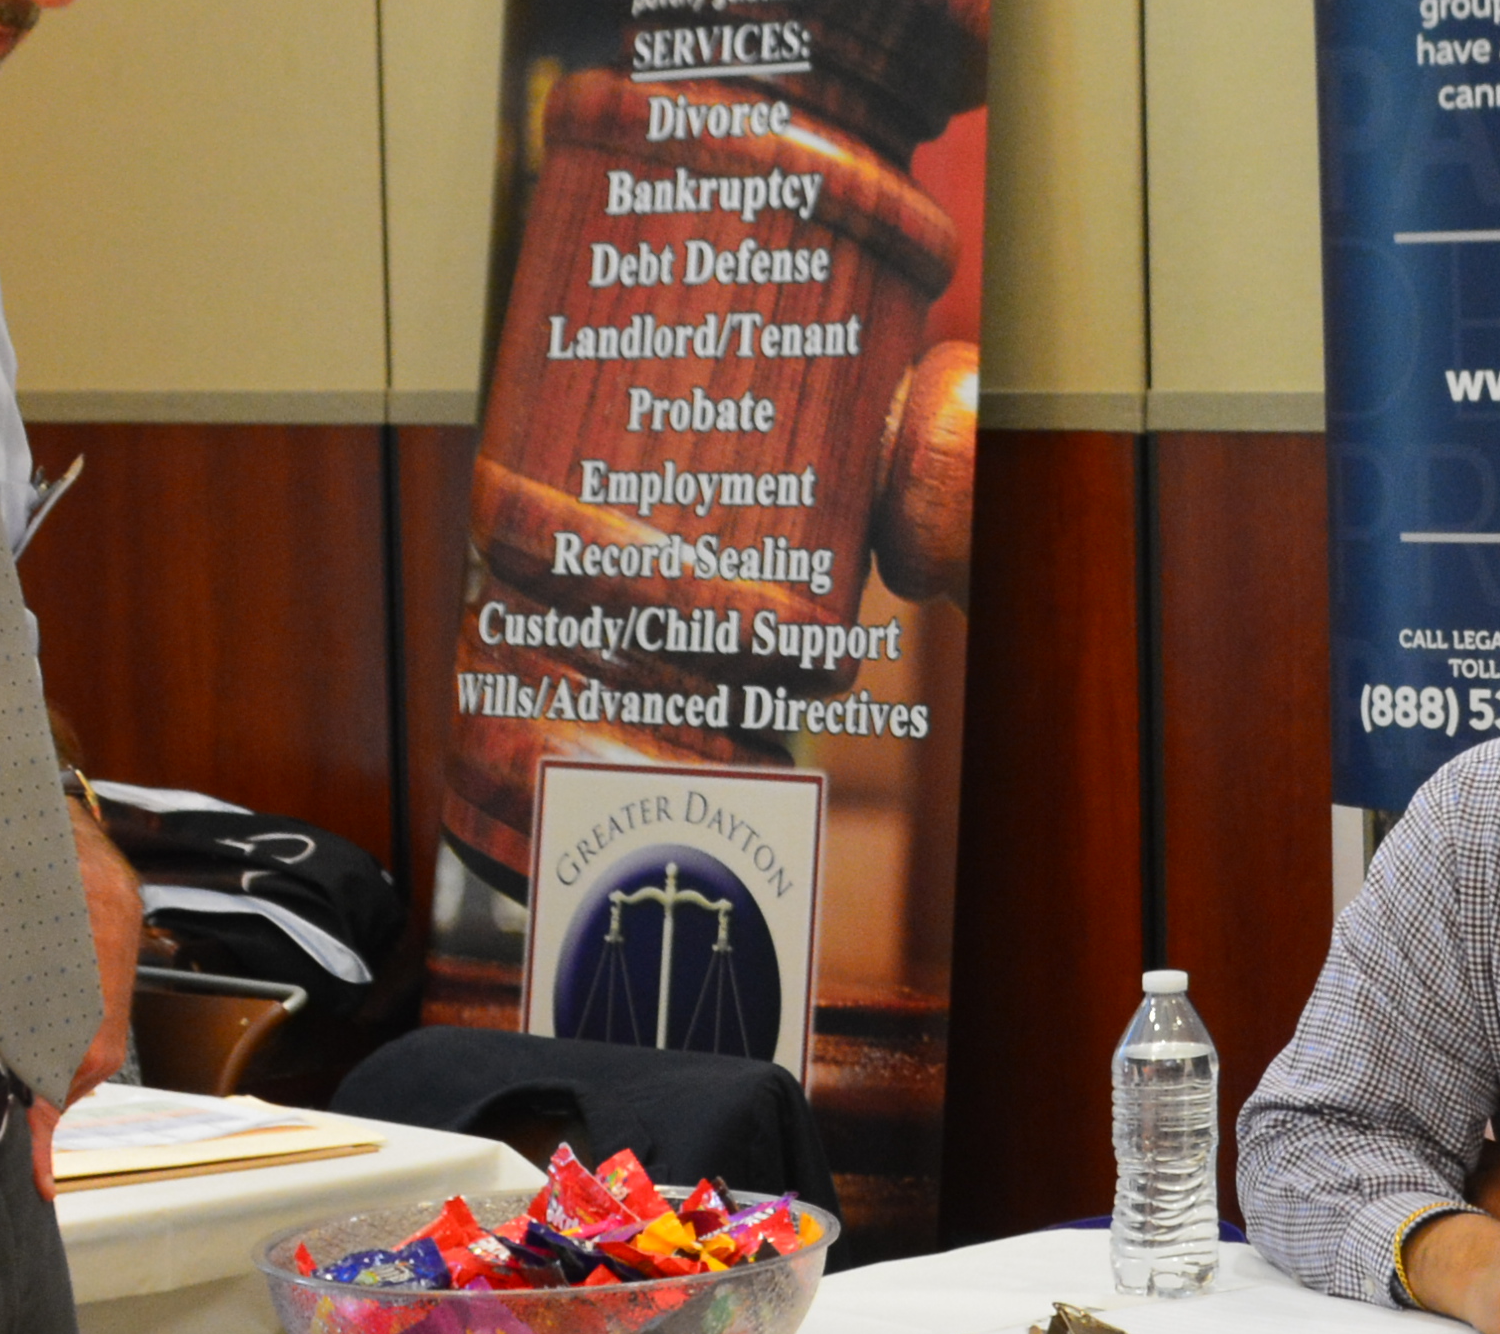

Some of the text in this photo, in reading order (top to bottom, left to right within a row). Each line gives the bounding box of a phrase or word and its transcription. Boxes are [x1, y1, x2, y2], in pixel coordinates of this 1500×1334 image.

[632, 22, 810, 70] SERVICES:
[1416, 33, 1491, 66] have
[646, 95, 789, 141] Divorce
[605, 168, 823, 221] Bankruptcy
[589, 238, 829, 288] Debt Defense
[548, 313, 860, 360] Landlord/Tenant
[627, 387, 775, 431] Probate
[580, 460, 816, 516] Employment
[551, 532, 832, 594] Record Sealing
[478, 601, 900, 670] Custody/Child Support
[1399, 628, 1448, 649] CALL
[456, 672, 929, 739] Wills/Advanced Directives
[1361, 684, 1459, 737] (888)
[555, 791, 794, 899] GREATER DAYTON
